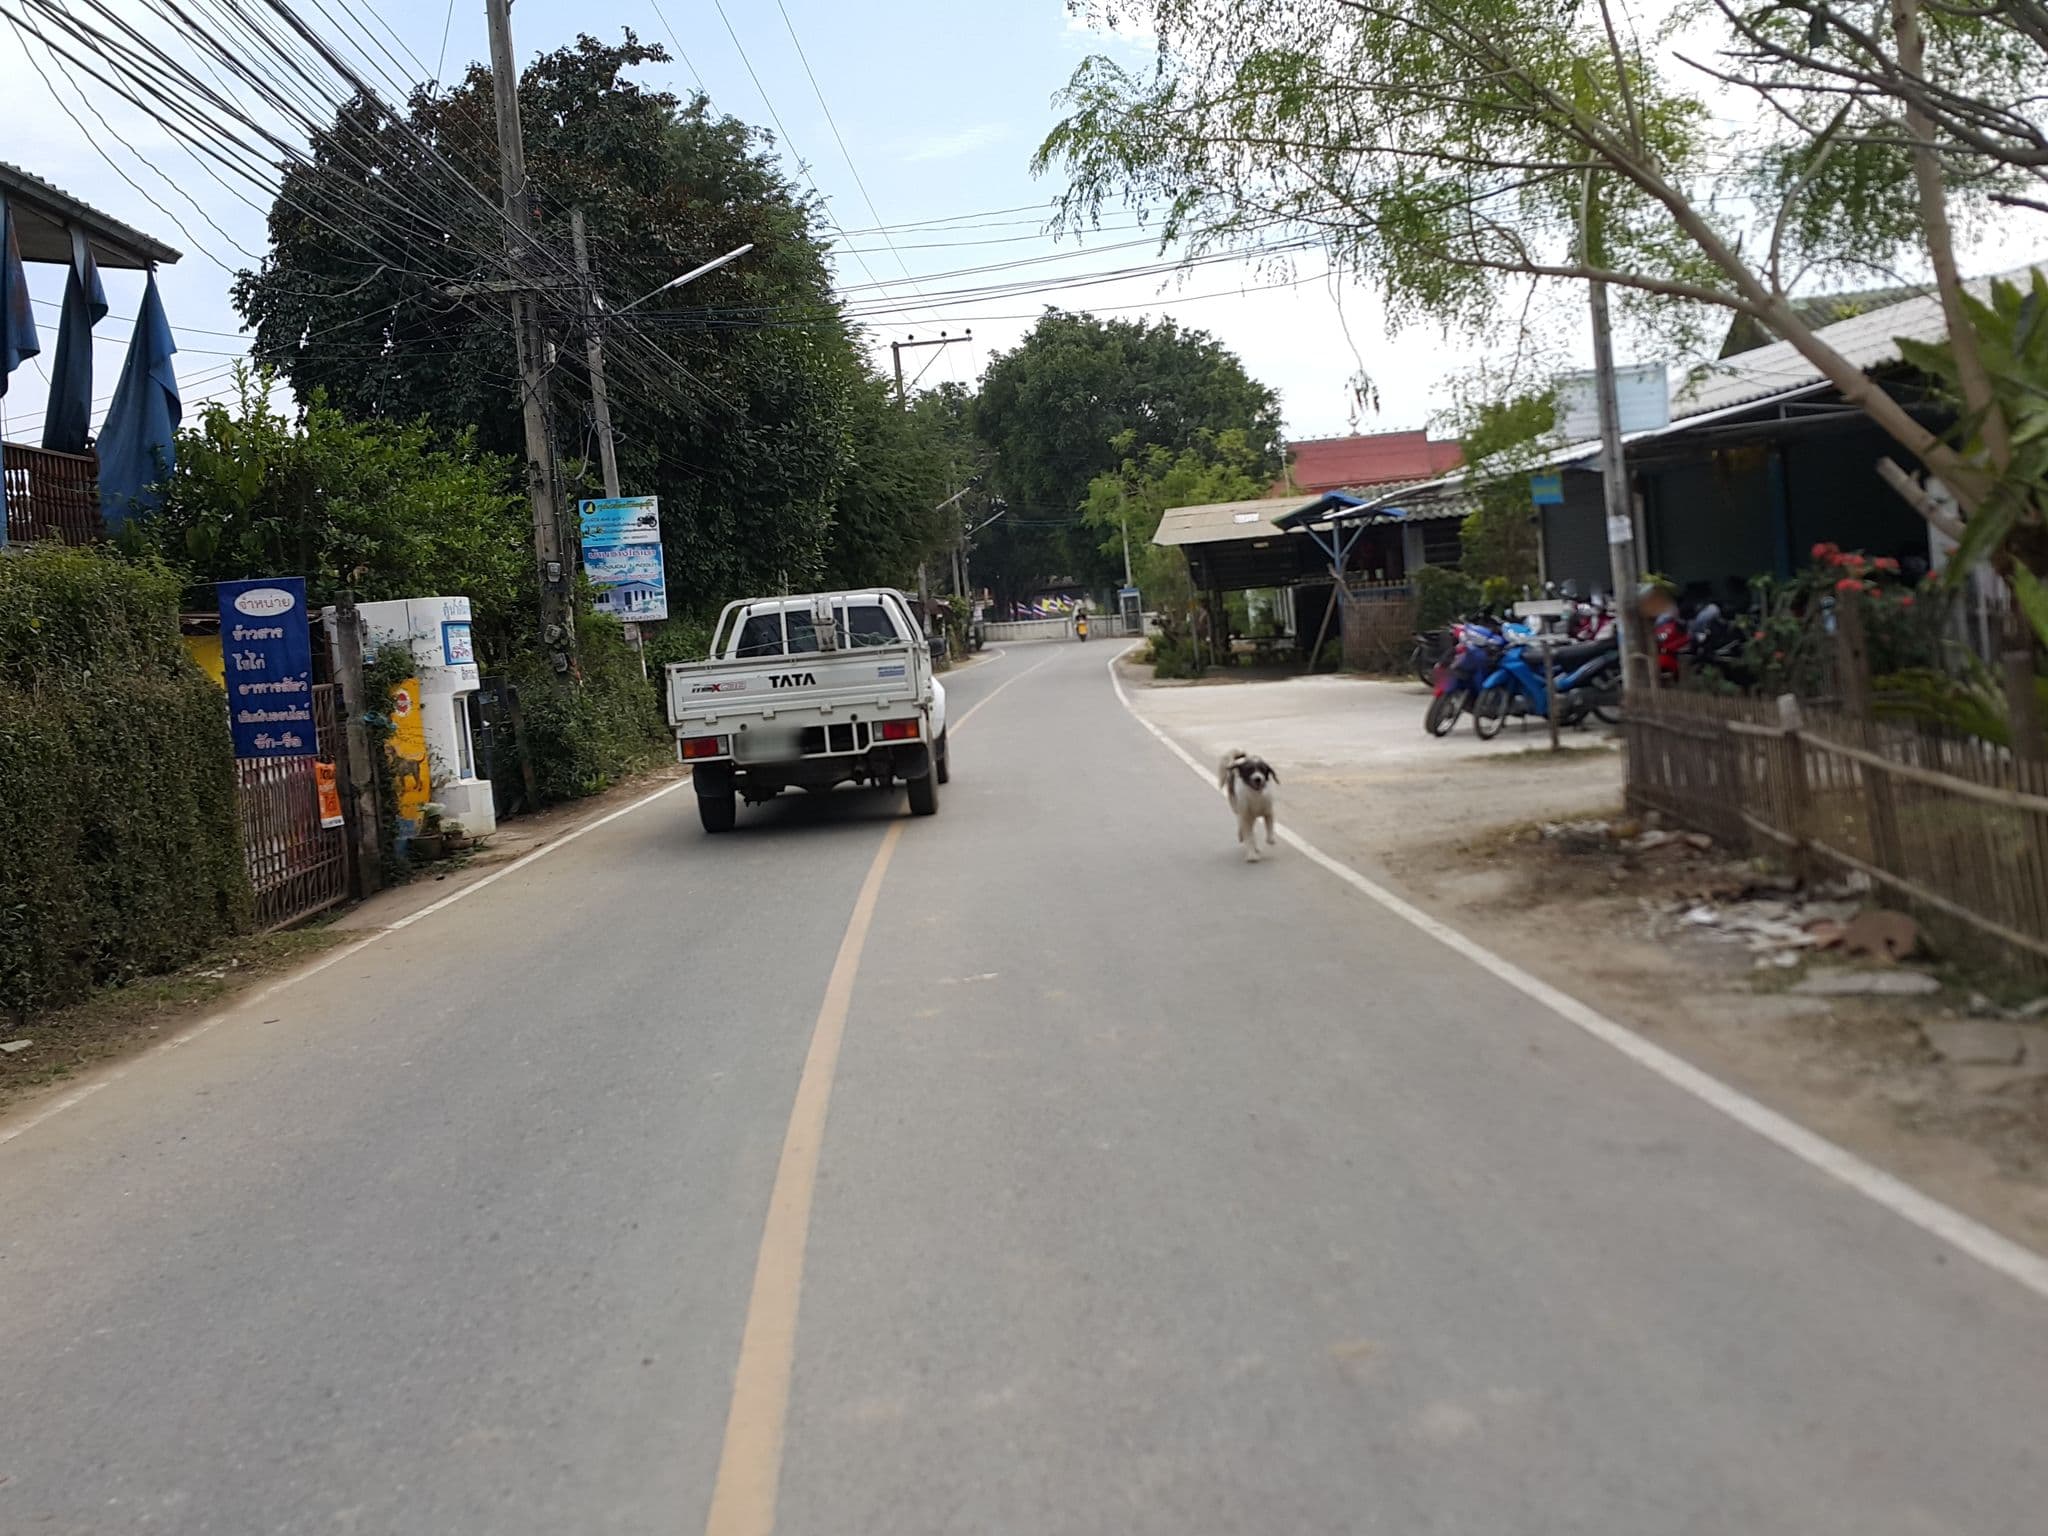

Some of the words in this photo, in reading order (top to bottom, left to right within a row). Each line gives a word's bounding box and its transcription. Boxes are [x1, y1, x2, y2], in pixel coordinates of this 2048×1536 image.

[239, 594, 291, 611] จำหน่าย
[232, 625, 283, 641] ข้าวสาร
[232, 650, 266, 671] ไข่ไก่
[238, 672, 308, 696] อาหารสัตว์
[768, 673, 816, 688] TATA
